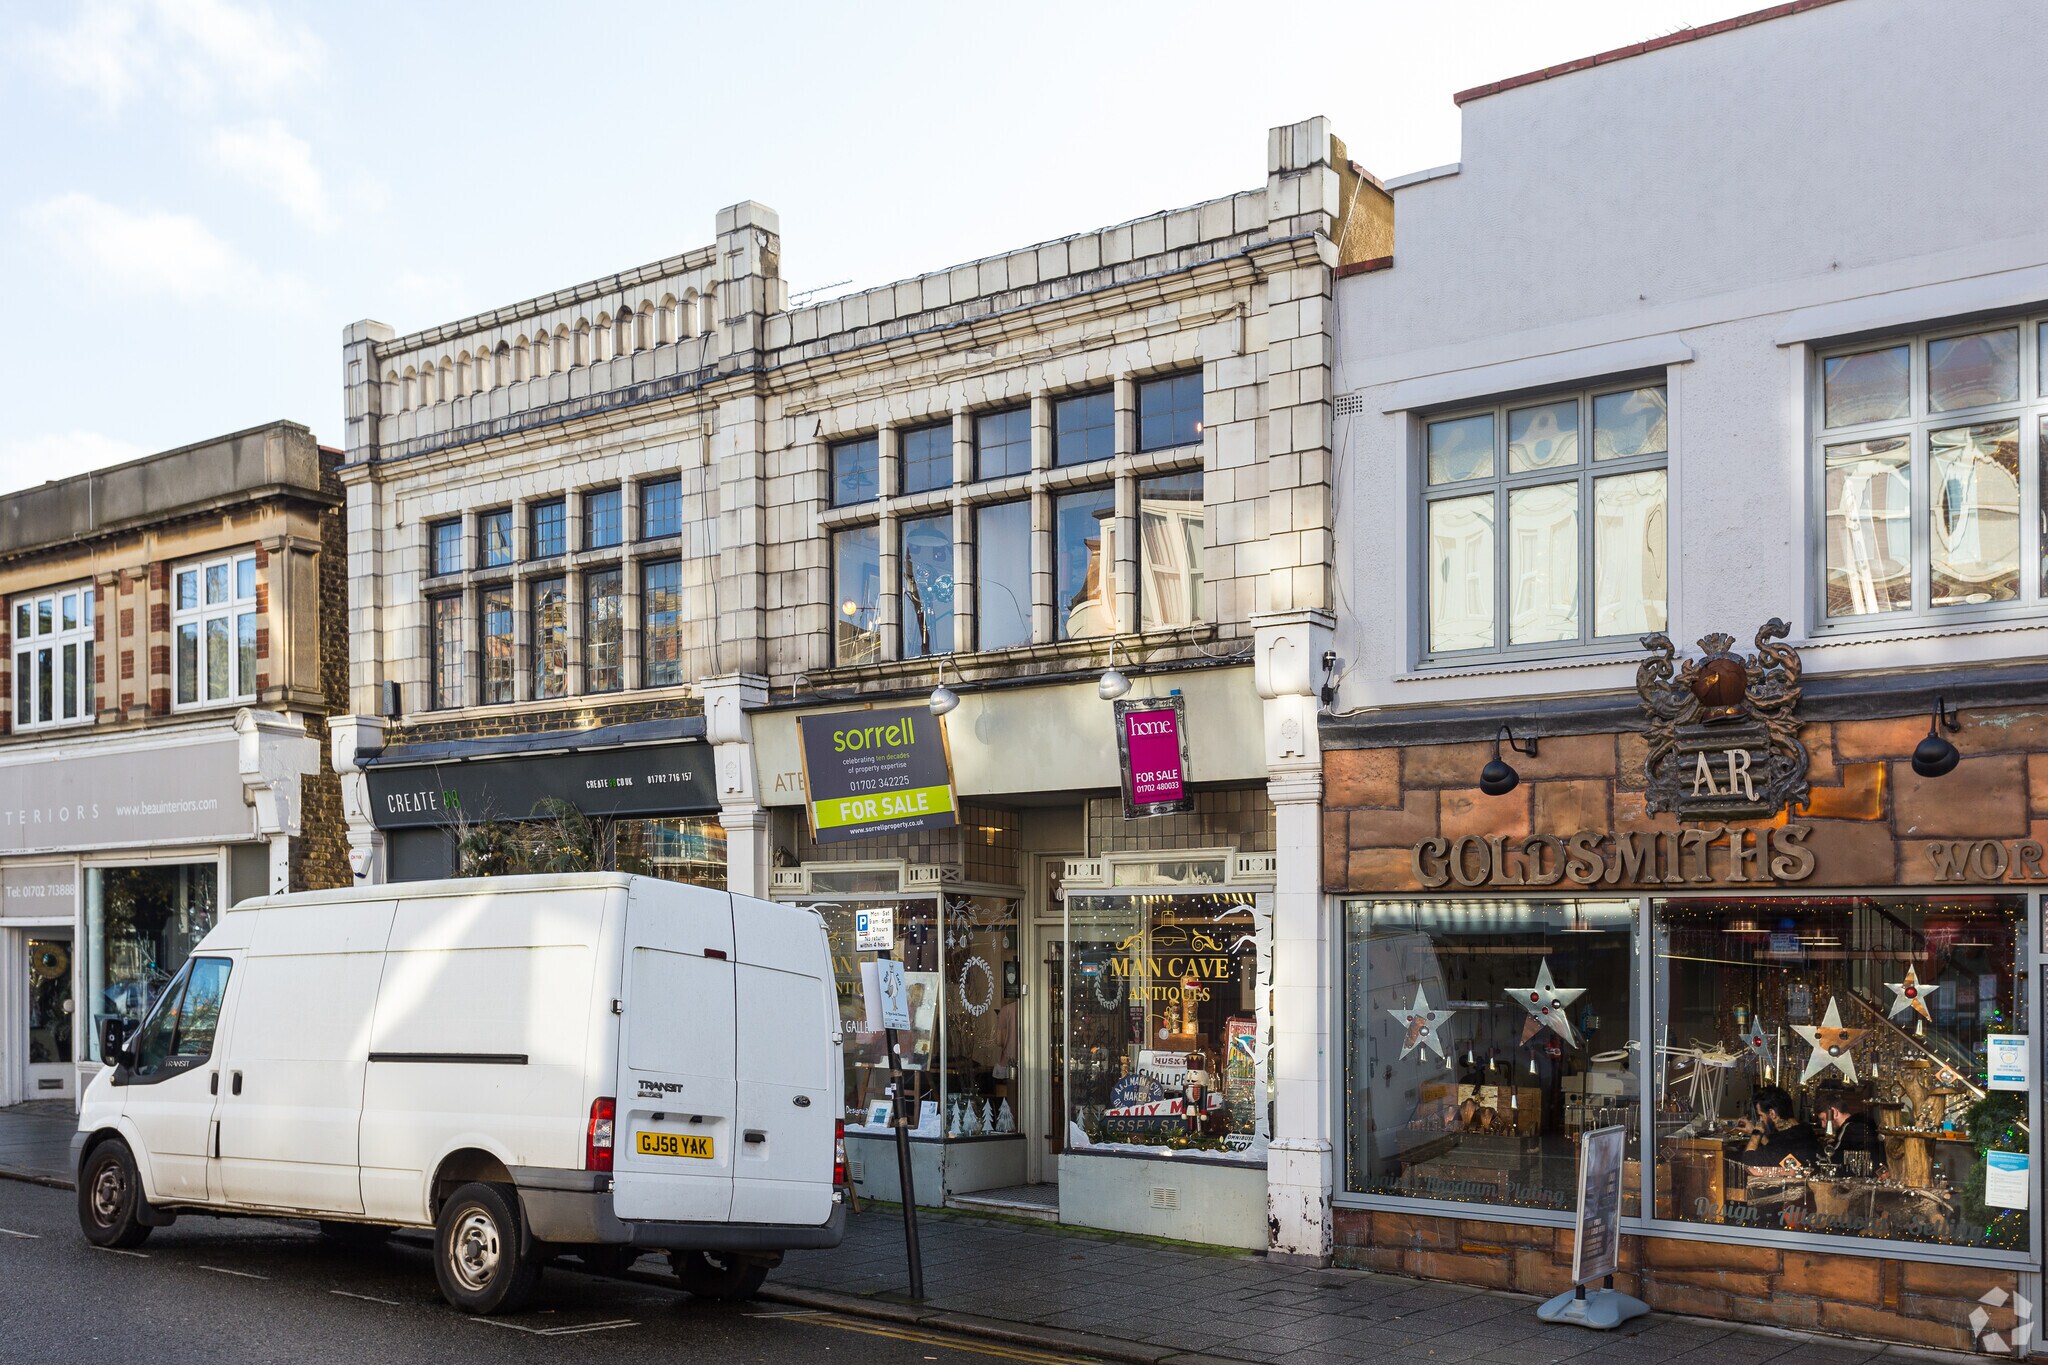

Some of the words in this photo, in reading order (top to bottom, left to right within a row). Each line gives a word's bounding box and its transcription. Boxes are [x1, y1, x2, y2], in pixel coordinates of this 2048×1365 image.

[833, 717, 915, 753] sorrell
[842, 755, 875, 766] celebrating
[886, 752, 910, 761] decades
[848, 766, 855, 774] of
[855, 764, 880, 775] property
[881, 762, 907, 772] expertise
[1136, 771, 1155, 783] FOR
[1156, 769, 1178, 781] SALE
[647, 774, 667, 785] 01702
[682, 771, 692, 782] 157
[850, 779, 877, 792] 01702
[878, 775, 910, 789] 342225
[1136, 784, 1155, 793] 01702
[1156, 781, 1179, 791] 480033
[116, 799, 218, 817] www.beauinteriors.com
[387, 791, 438, 813] CREATE
[840, 799, 879, 822] FOR
[881, 793, 929, 816] SALE
[849, 819, 924, 835] www.sorrellproperty.co.uk
[1411, 823, 1816, 888] GOLDSMITHS
[6, 886, 21, 898] Tel:
[23, 885, 45, 897] 01702
[1110, 957, 1162, 978] MAN
[1168, 957, 1229, 979] CAVE
[1128, 986, 1211, 1006] ANTIQUES
[1155, 1057, 1188, 1066] HUSKY
[638, 1080, 683, 1093] TRANSIT
[642, 1135, 678, 1153] GJ58
[681, 1137, 707, 1155] YAK
[1425, 1176, 1499, 1198] Rhodium
[1506, 1180, 1566, 1207] Plating
[1694, 1196, 1760, 1224] Design
